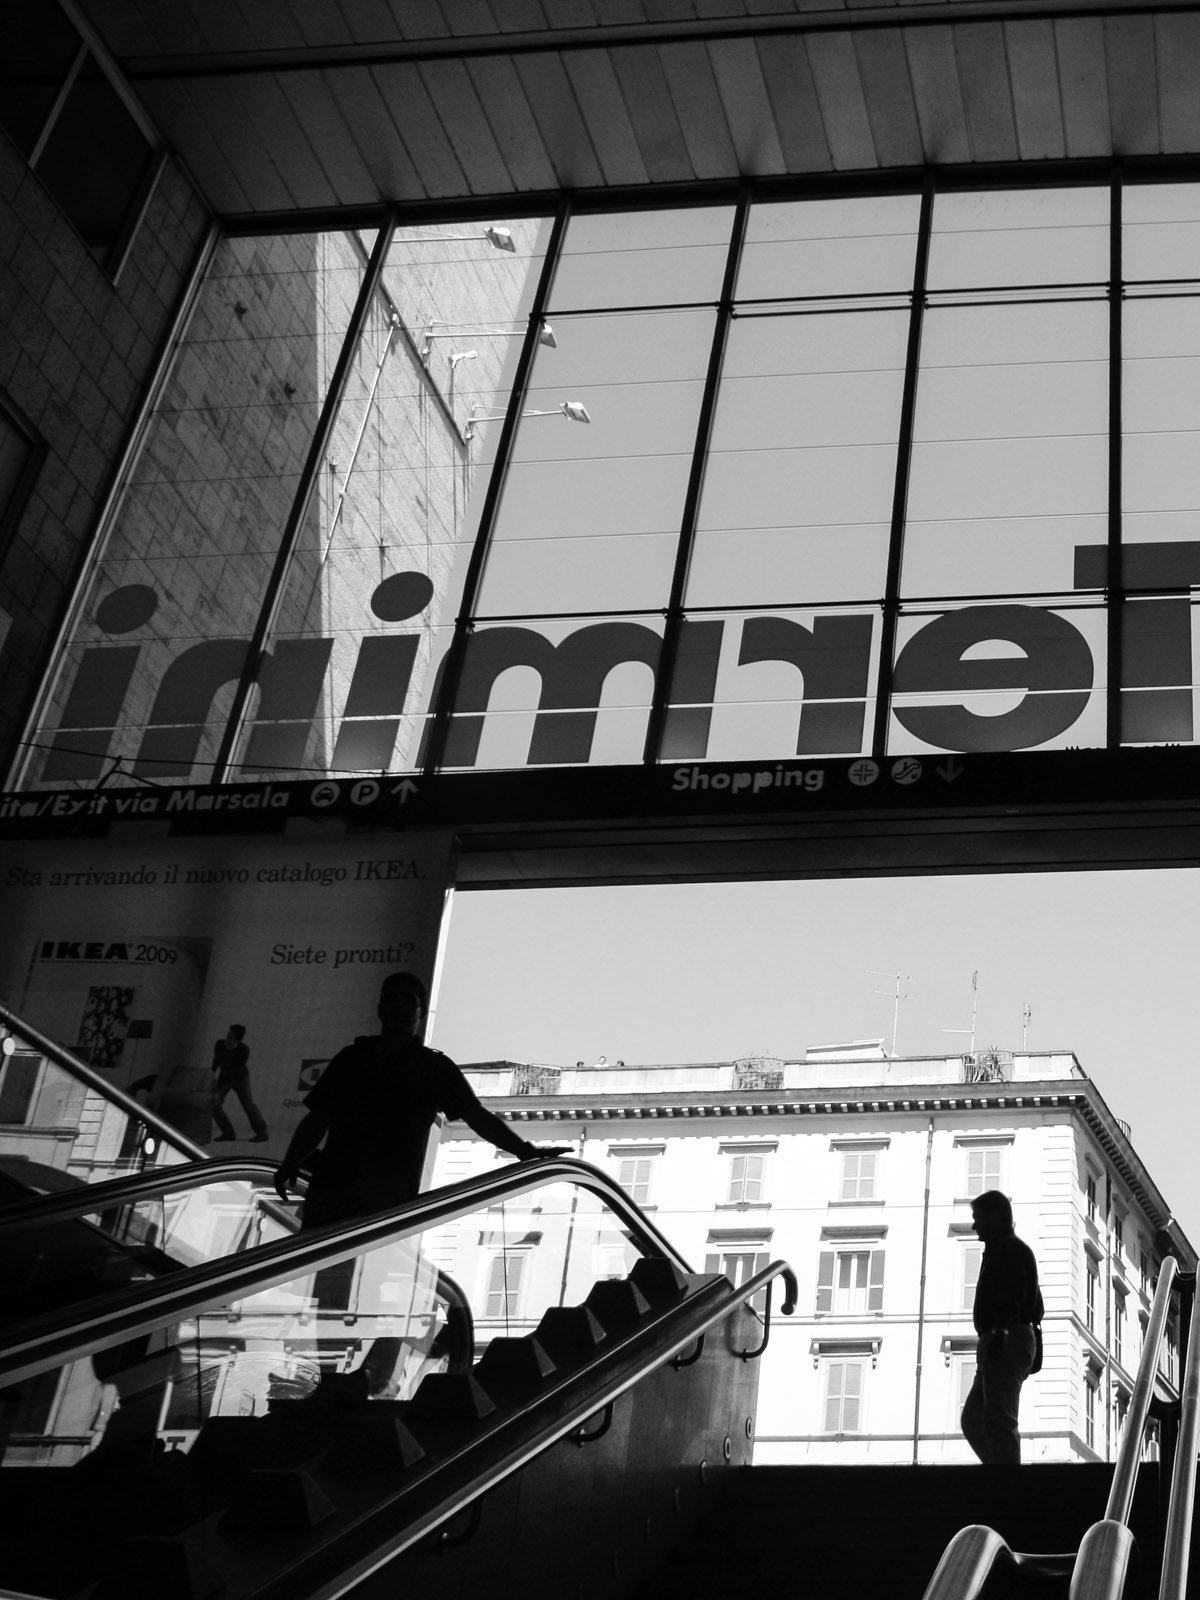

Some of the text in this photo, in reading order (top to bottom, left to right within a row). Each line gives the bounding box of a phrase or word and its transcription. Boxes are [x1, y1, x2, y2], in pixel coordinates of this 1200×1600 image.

[672, 764, 825, 794] Shopping
[115, 793, 158, 813] via
[165, 786, 290, 812] Marsala
[6, 867, 42, 886] Sta
[49, 866, 156, 886] arrivando
[164, 865, 179, 885] il
[185, 868, 249, 885] nuovo
[256, 862, 347, 886] catalogo
[40, 942, 178, 964] IKEA 2009
[270, 942, 416, 967] Siete pronti?
